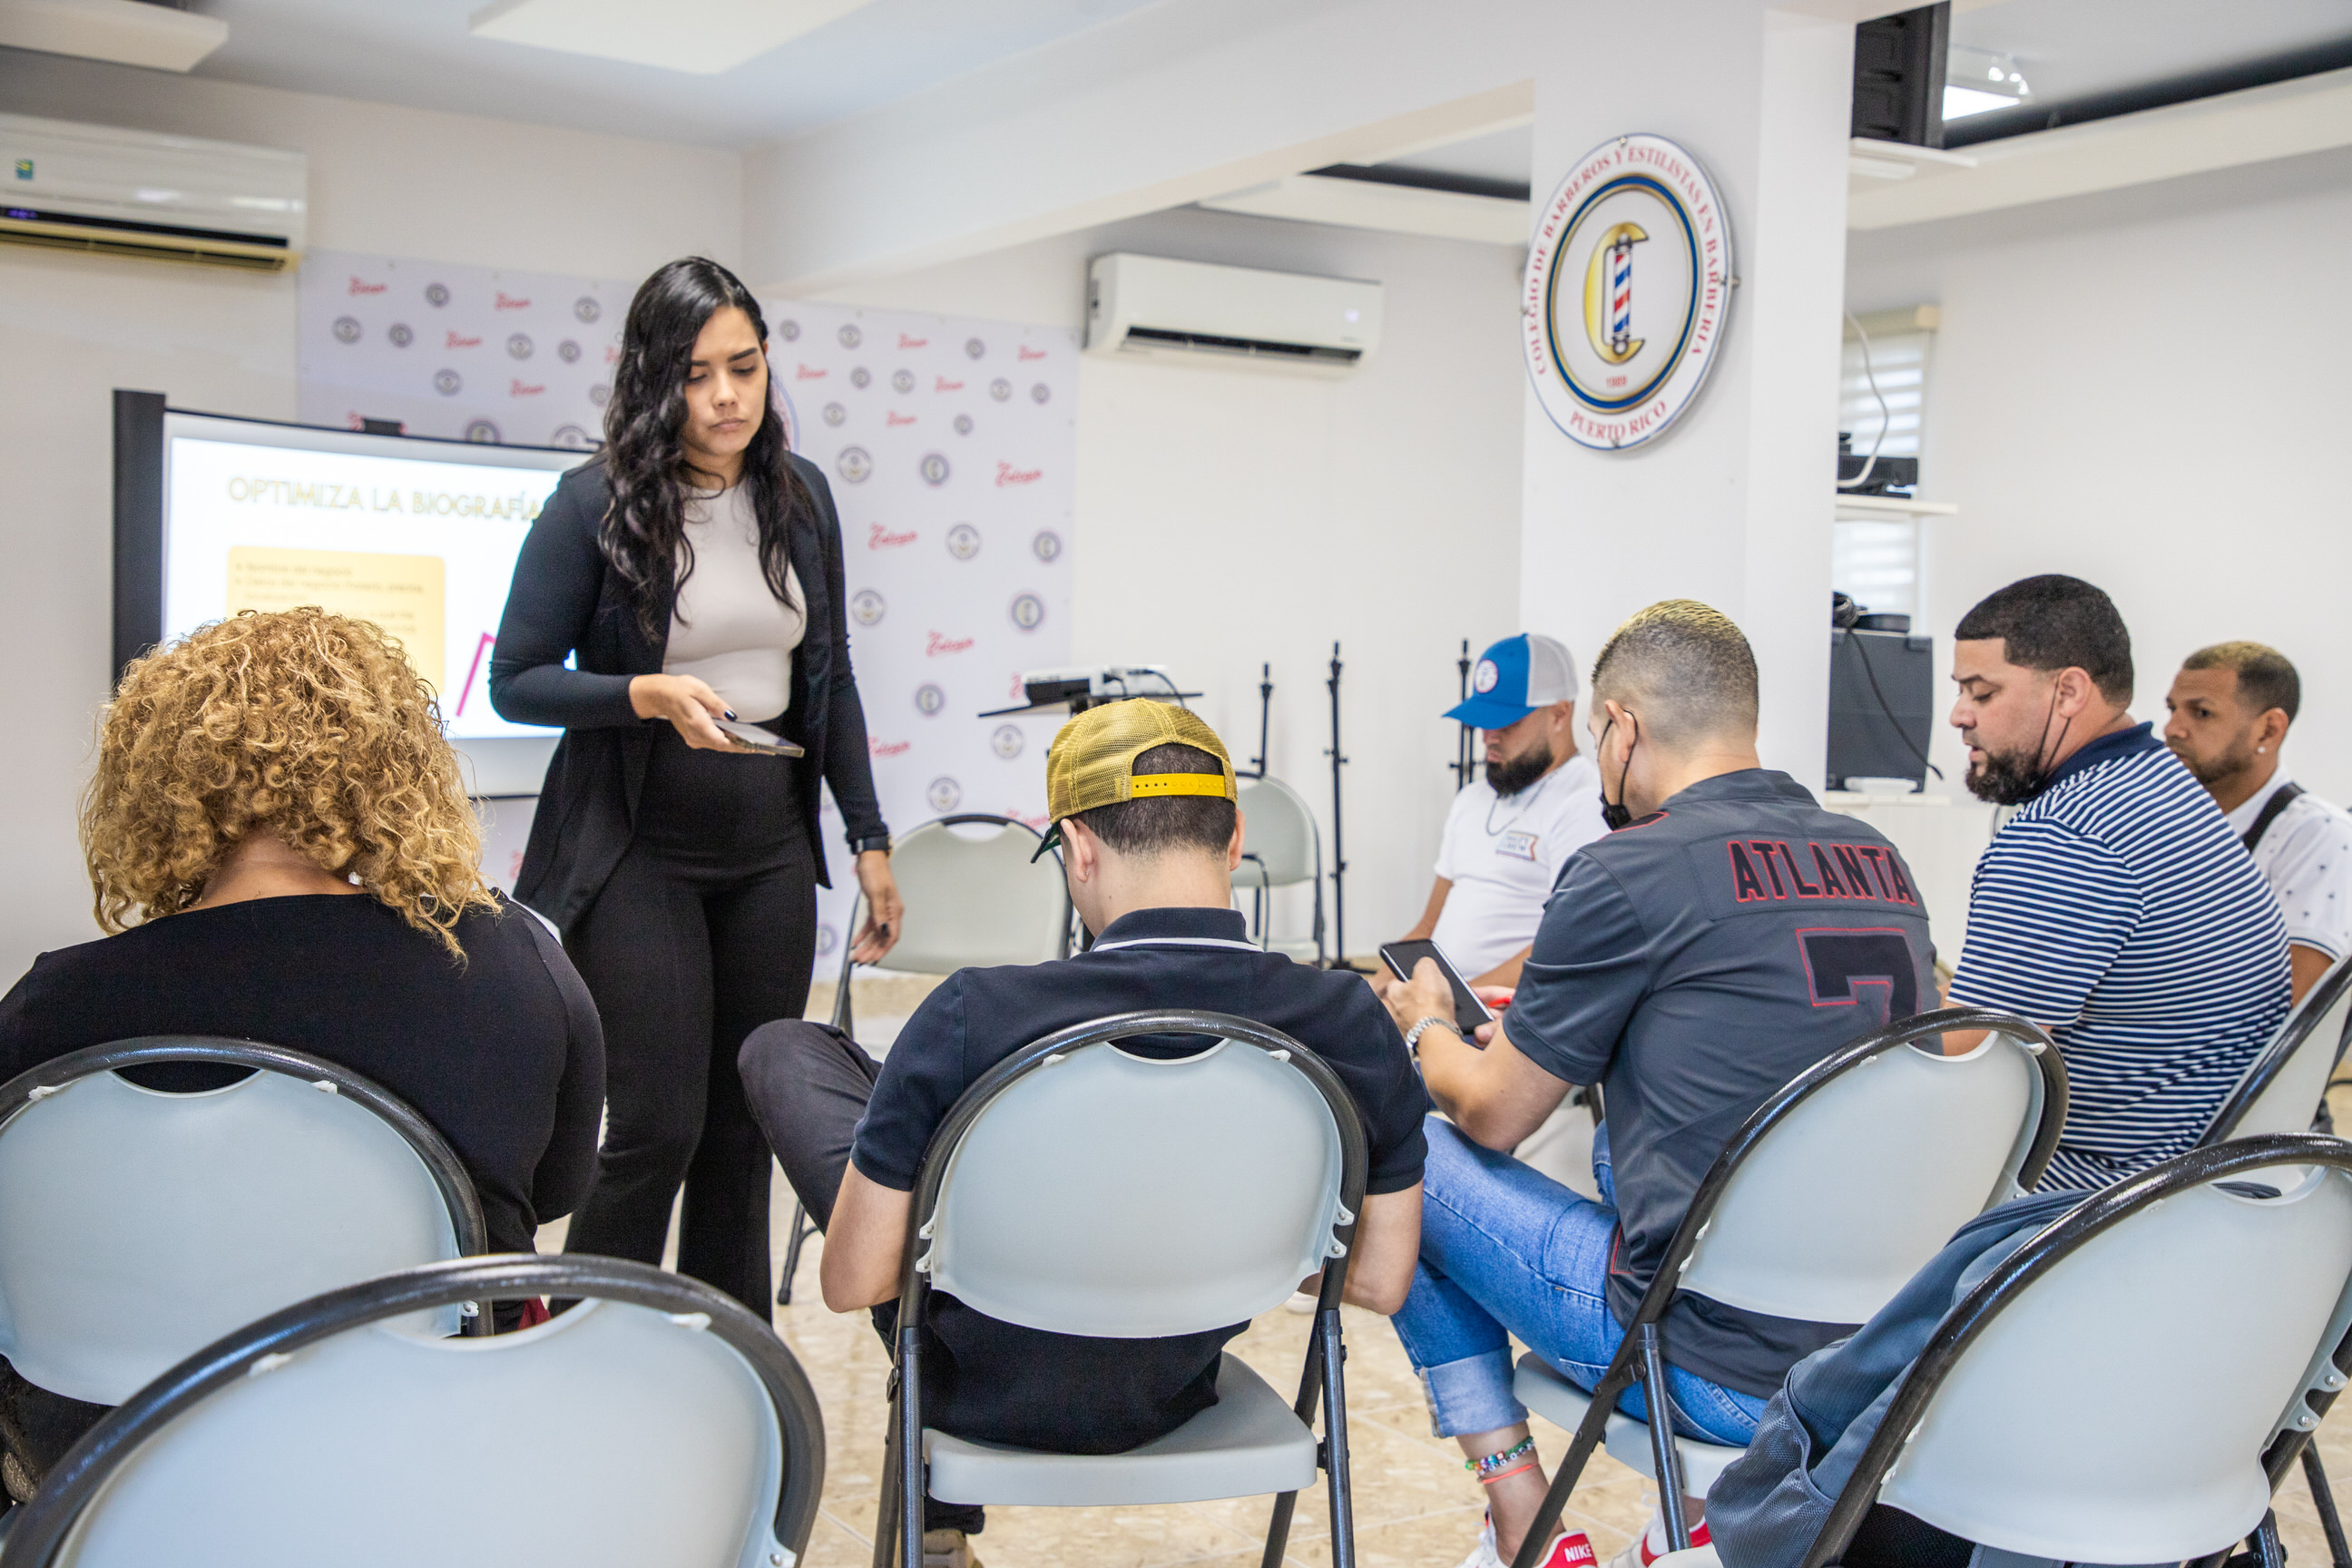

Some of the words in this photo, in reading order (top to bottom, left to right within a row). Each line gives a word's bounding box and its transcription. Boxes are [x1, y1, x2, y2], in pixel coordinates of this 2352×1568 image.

[1614, 148, 1625, 165] Y
[1627, 146, 1701, 204] ESTILISTAS
[1544, 154, 1611, 238] BARBEROS
[1698, 203, 1713, 233] EN
[1533, 247, 1546, 271] DE
[1528, 278, 1546, 375] COLEGIO
[1570, 411, 1626, 440] PUERTO
[1629, 400, 1667, 436] RICO
[228, 476, 365, 510] OPTIMIZA
[373, 488, 404, 514] LA
[1727, 840, 1917, 906] ATLANTA
[1563, 1544, 1592, 1563] NIKE
